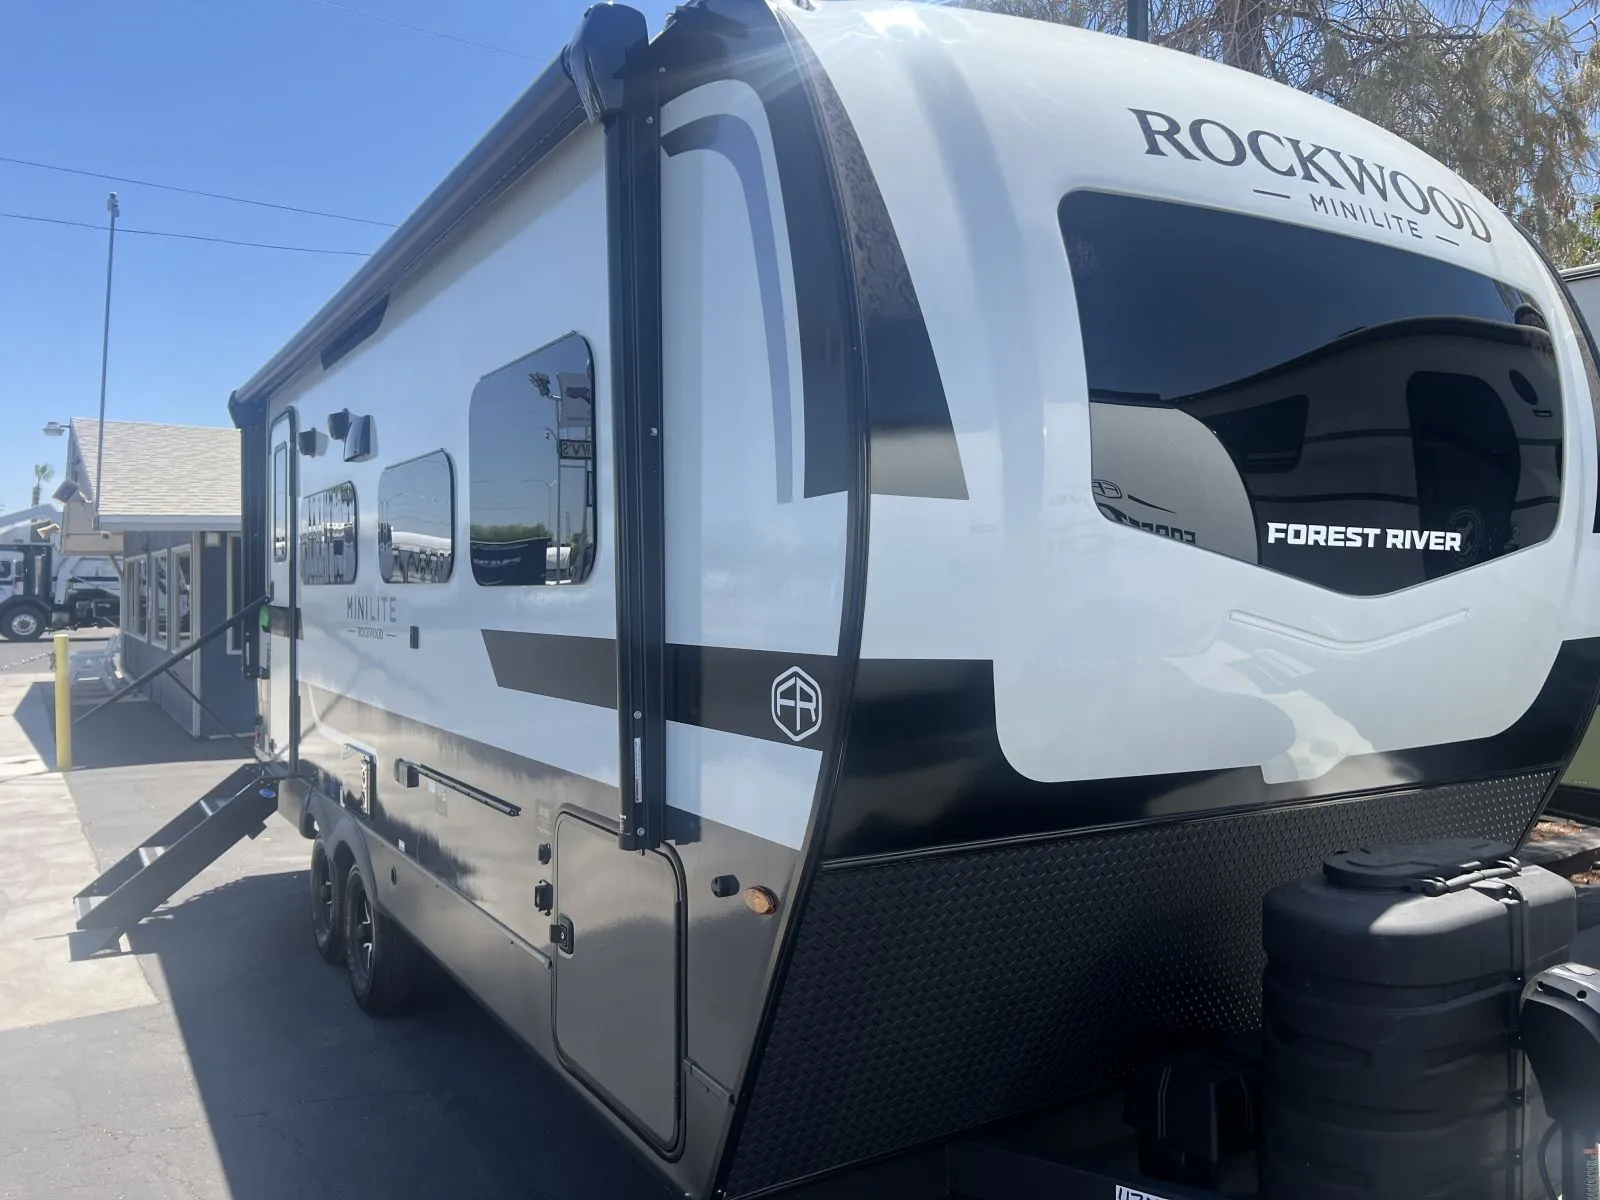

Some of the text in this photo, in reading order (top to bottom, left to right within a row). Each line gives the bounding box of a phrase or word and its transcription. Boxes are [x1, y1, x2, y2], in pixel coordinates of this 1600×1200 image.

[1127, 108, 1492, 244] ROCKWOOD
[1309, 193, 1423, 239] MINILITE
[1267, 522, 1462, 552] FOREST RIVER
[346, 595, 397, 623] MINILITE
